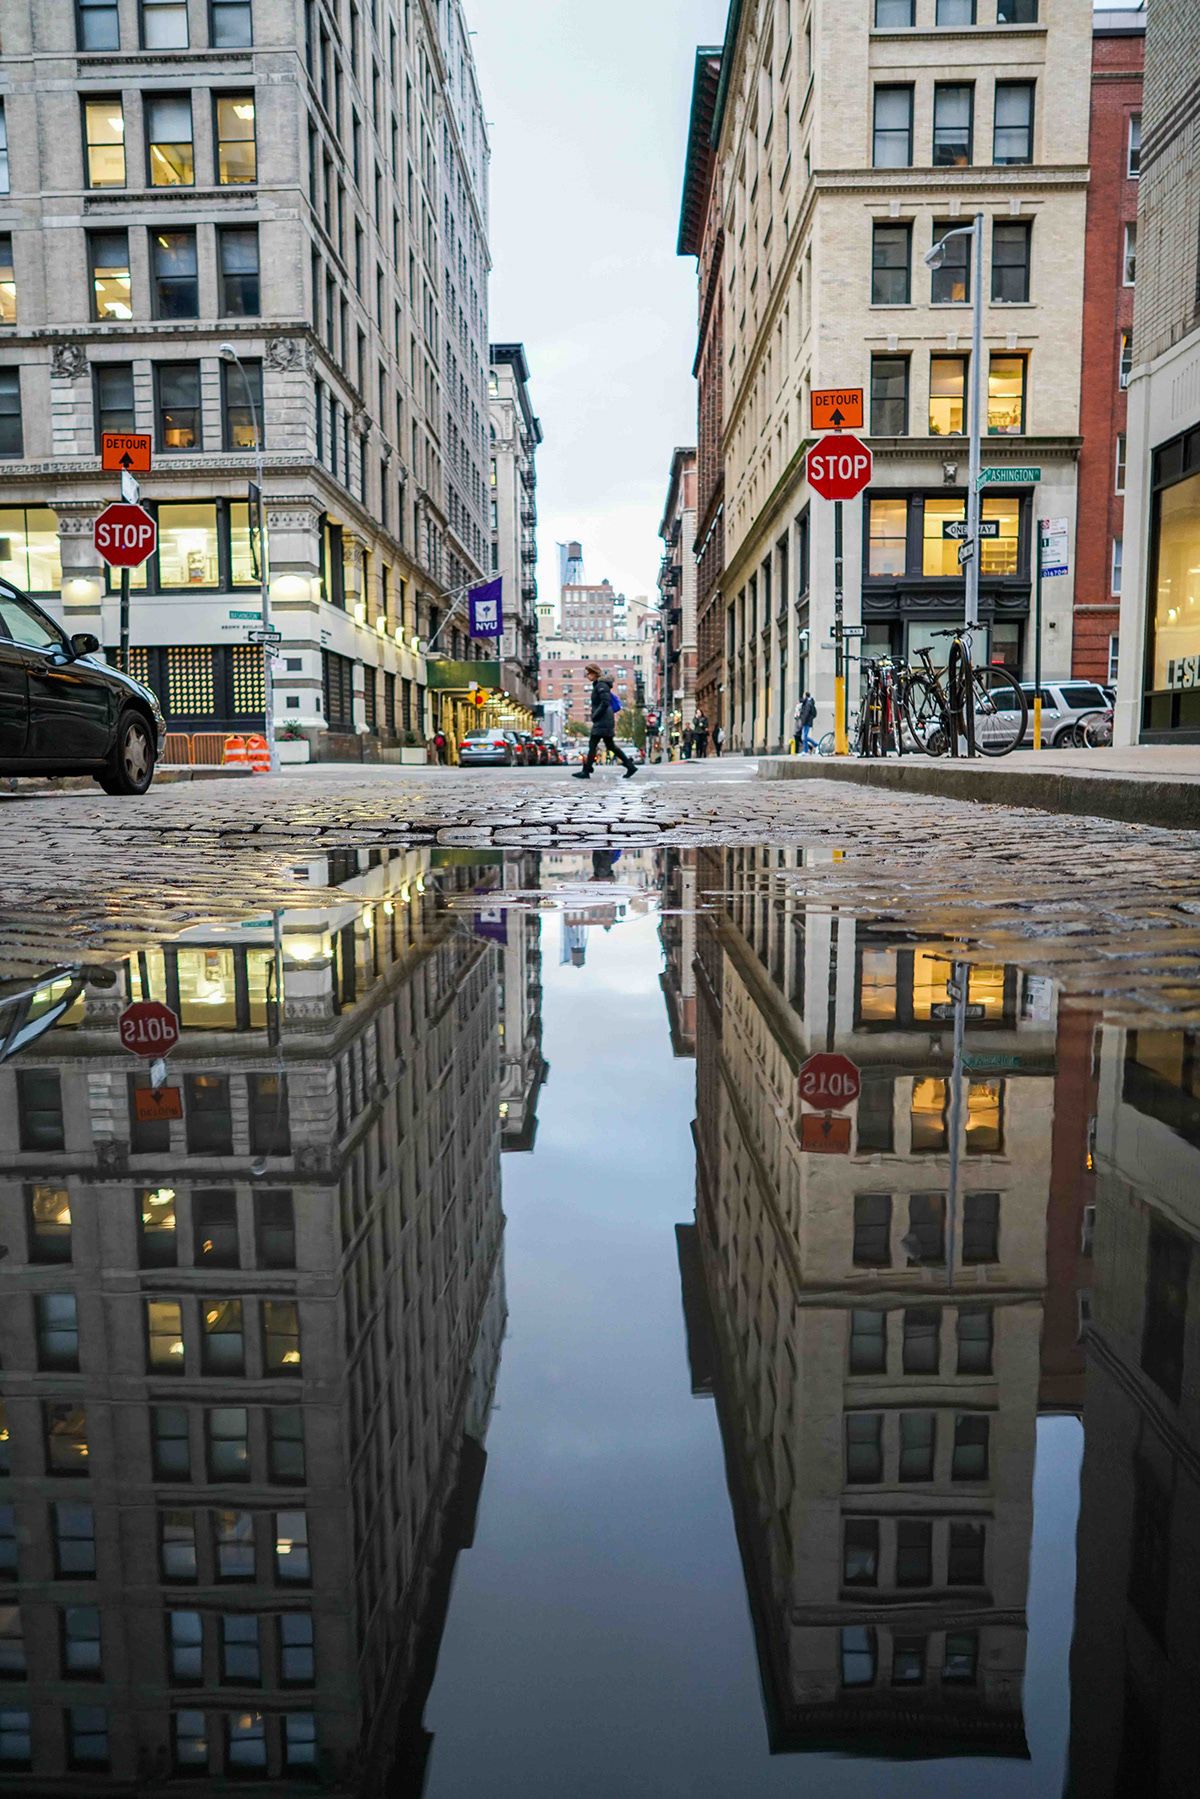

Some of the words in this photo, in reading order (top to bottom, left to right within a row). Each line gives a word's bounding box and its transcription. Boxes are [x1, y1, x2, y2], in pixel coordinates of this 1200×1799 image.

[815, 394, 859, 406] DETOUR
[106, 438, 147, 450] DETOUR
[810, 454, 868, 480] STOP
[990, 469, 1034, 481] ASHINGTON
[97, 523, 152, 548] STOP
[950, 525, 967, 534] ONE
[475, 621, 498, 631] NYU
